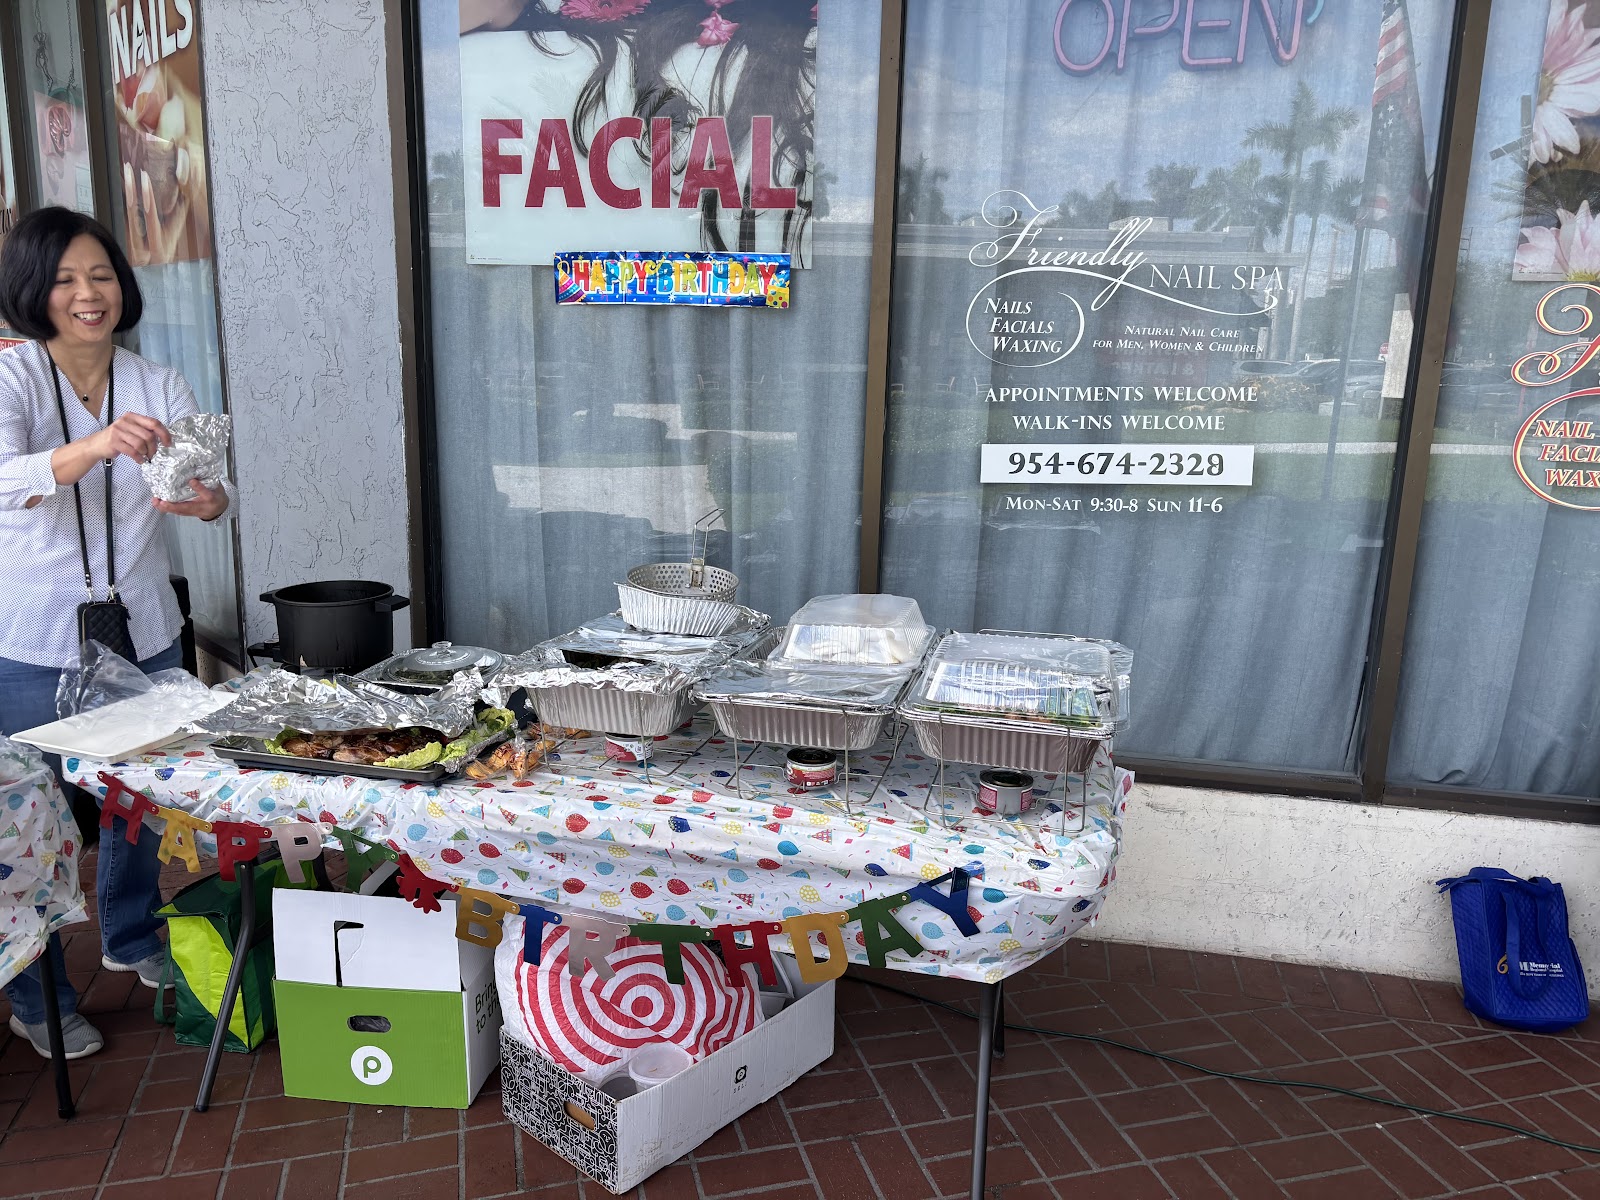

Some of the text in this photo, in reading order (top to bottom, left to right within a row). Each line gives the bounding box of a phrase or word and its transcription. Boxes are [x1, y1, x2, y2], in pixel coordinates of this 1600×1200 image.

[109, 0, 193, 85] NAILS
[1053, 0, 1300, 77] OPEN
[480, 116, 797, 210] FACIAL
[968, 189, 1154, 312] Friendly
[572, 259, 779, 297] HAPPY BIRTHDAY
[1149, 263, 1285, 291] NAIL SPA
[983, 297, 1033, 315] NAILS
[988, 316, 1055, 335] FACIALS
[1124, 325, 1240, 339] NATURAL NAIL CARE
[991, 335, 1063, 354] WAXING
[1149, 339, 1192, 351] WOMEN
[1194, 341, 1204, 351] &
[1208, 341, 1265, 353] CHILDREN
[984, 386, 1258, 403] APPOINTMENTS WELCOME
[1012, 414, 1226, 431] WALK-INS WELCOME
[1005, 496, 1223, 514] MON-SAT 9:30-8 SUN 11-6
[97, 771, 983, 987] HAPPY BIRTHDAY
[487, 995, 500, 1018] th
